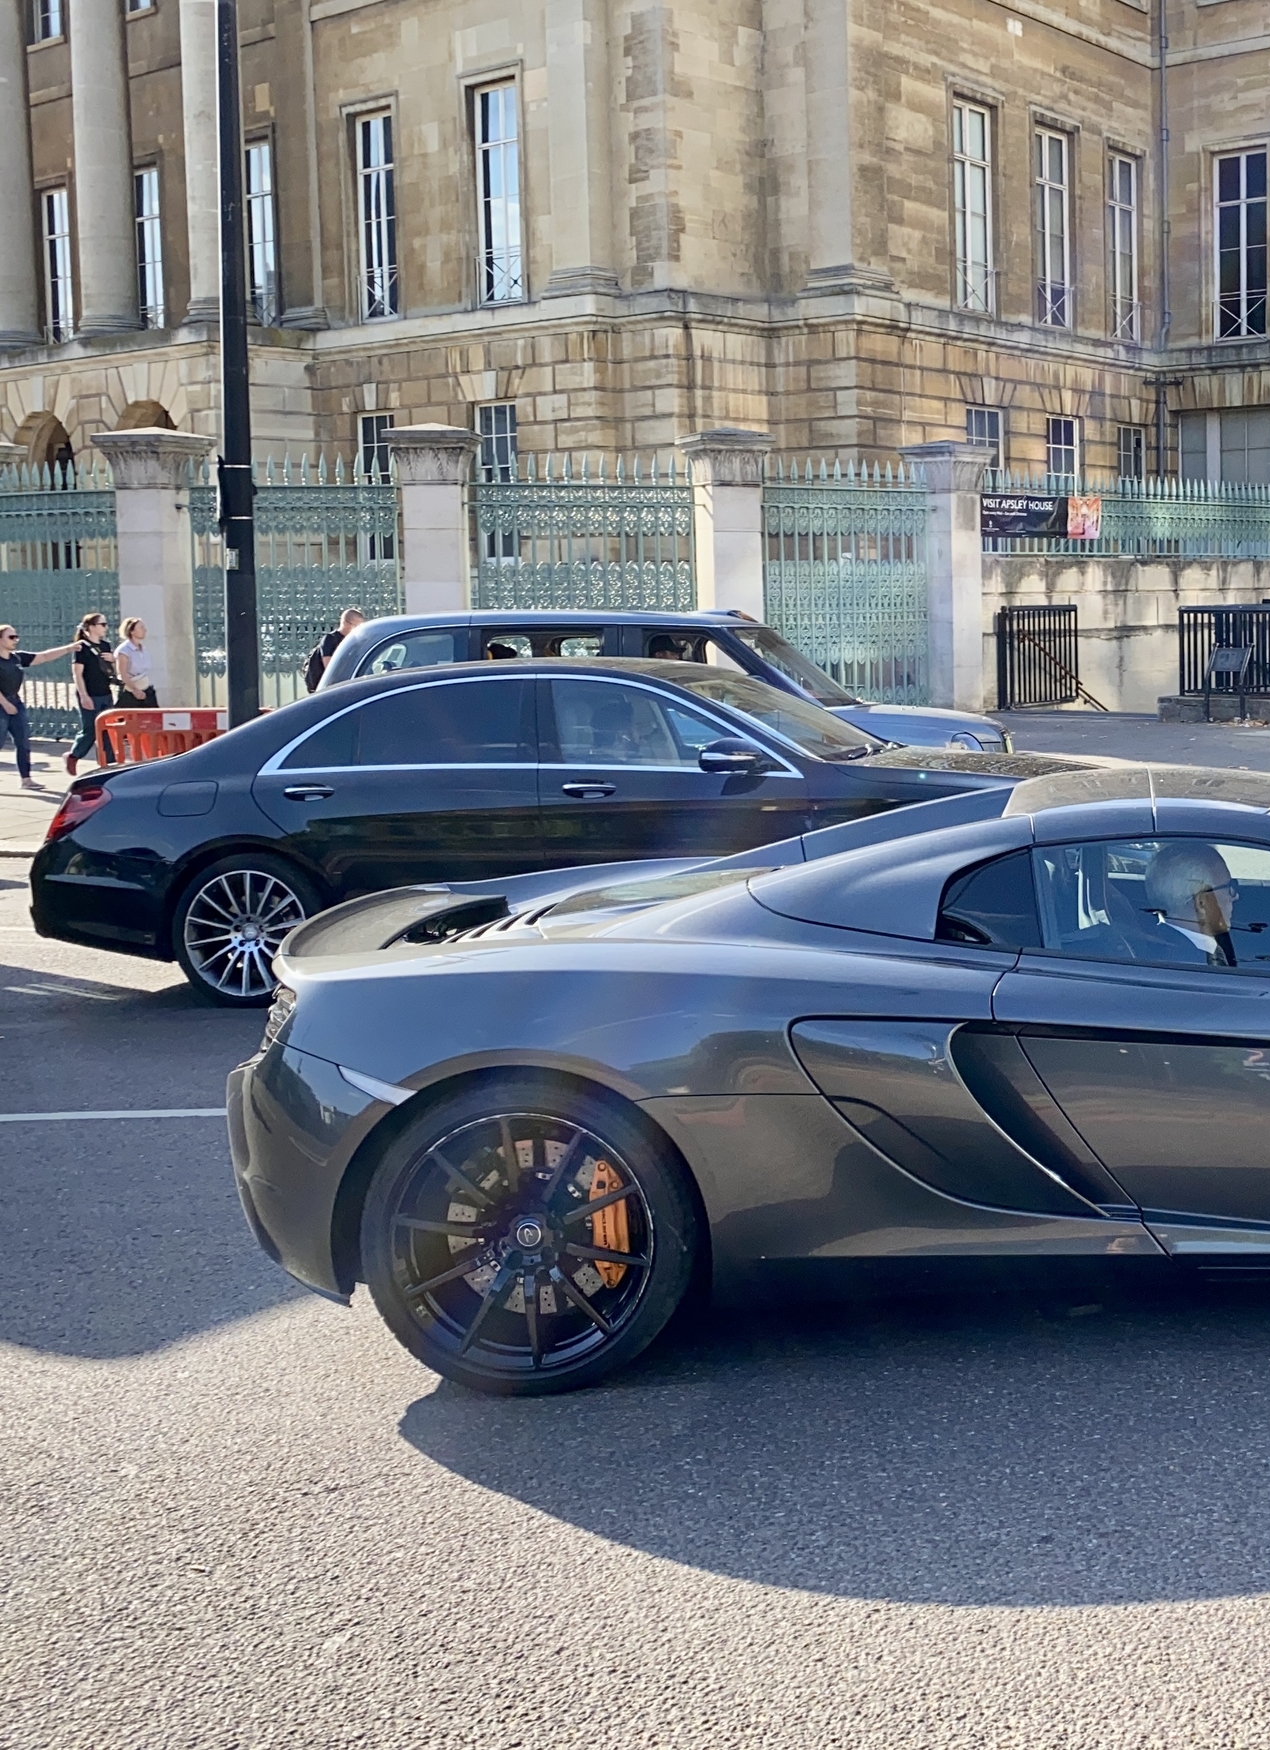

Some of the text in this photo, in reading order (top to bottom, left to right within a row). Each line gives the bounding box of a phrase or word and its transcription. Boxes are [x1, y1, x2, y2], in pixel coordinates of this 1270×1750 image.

[982, 498, 1054, 511] VISIT APSLEY HOUSE
